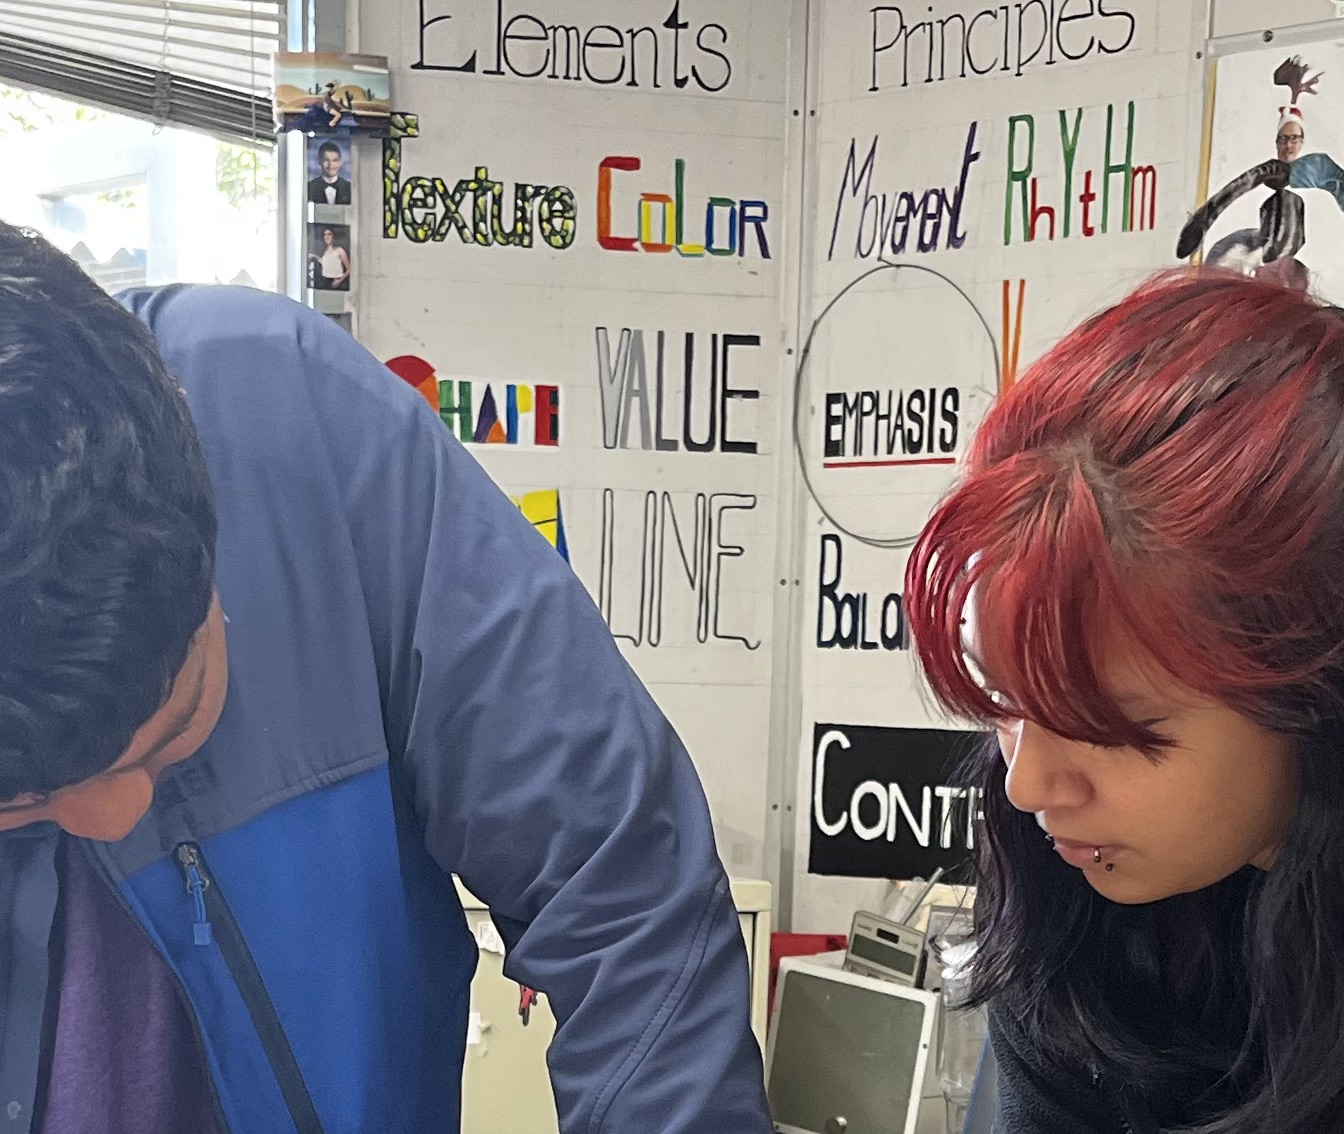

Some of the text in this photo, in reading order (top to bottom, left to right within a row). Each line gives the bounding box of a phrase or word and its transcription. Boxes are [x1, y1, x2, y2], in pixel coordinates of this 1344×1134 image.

[411, 0, 732, 91] Elements
[868, 0, 1136, 92] Principles
[382, 112, 578, 250] Texture
[595, 326, 761, 454] VALUE
[824, 387, 960, 458] EMPHASIS
[599, 488, 761, 650] LINE
